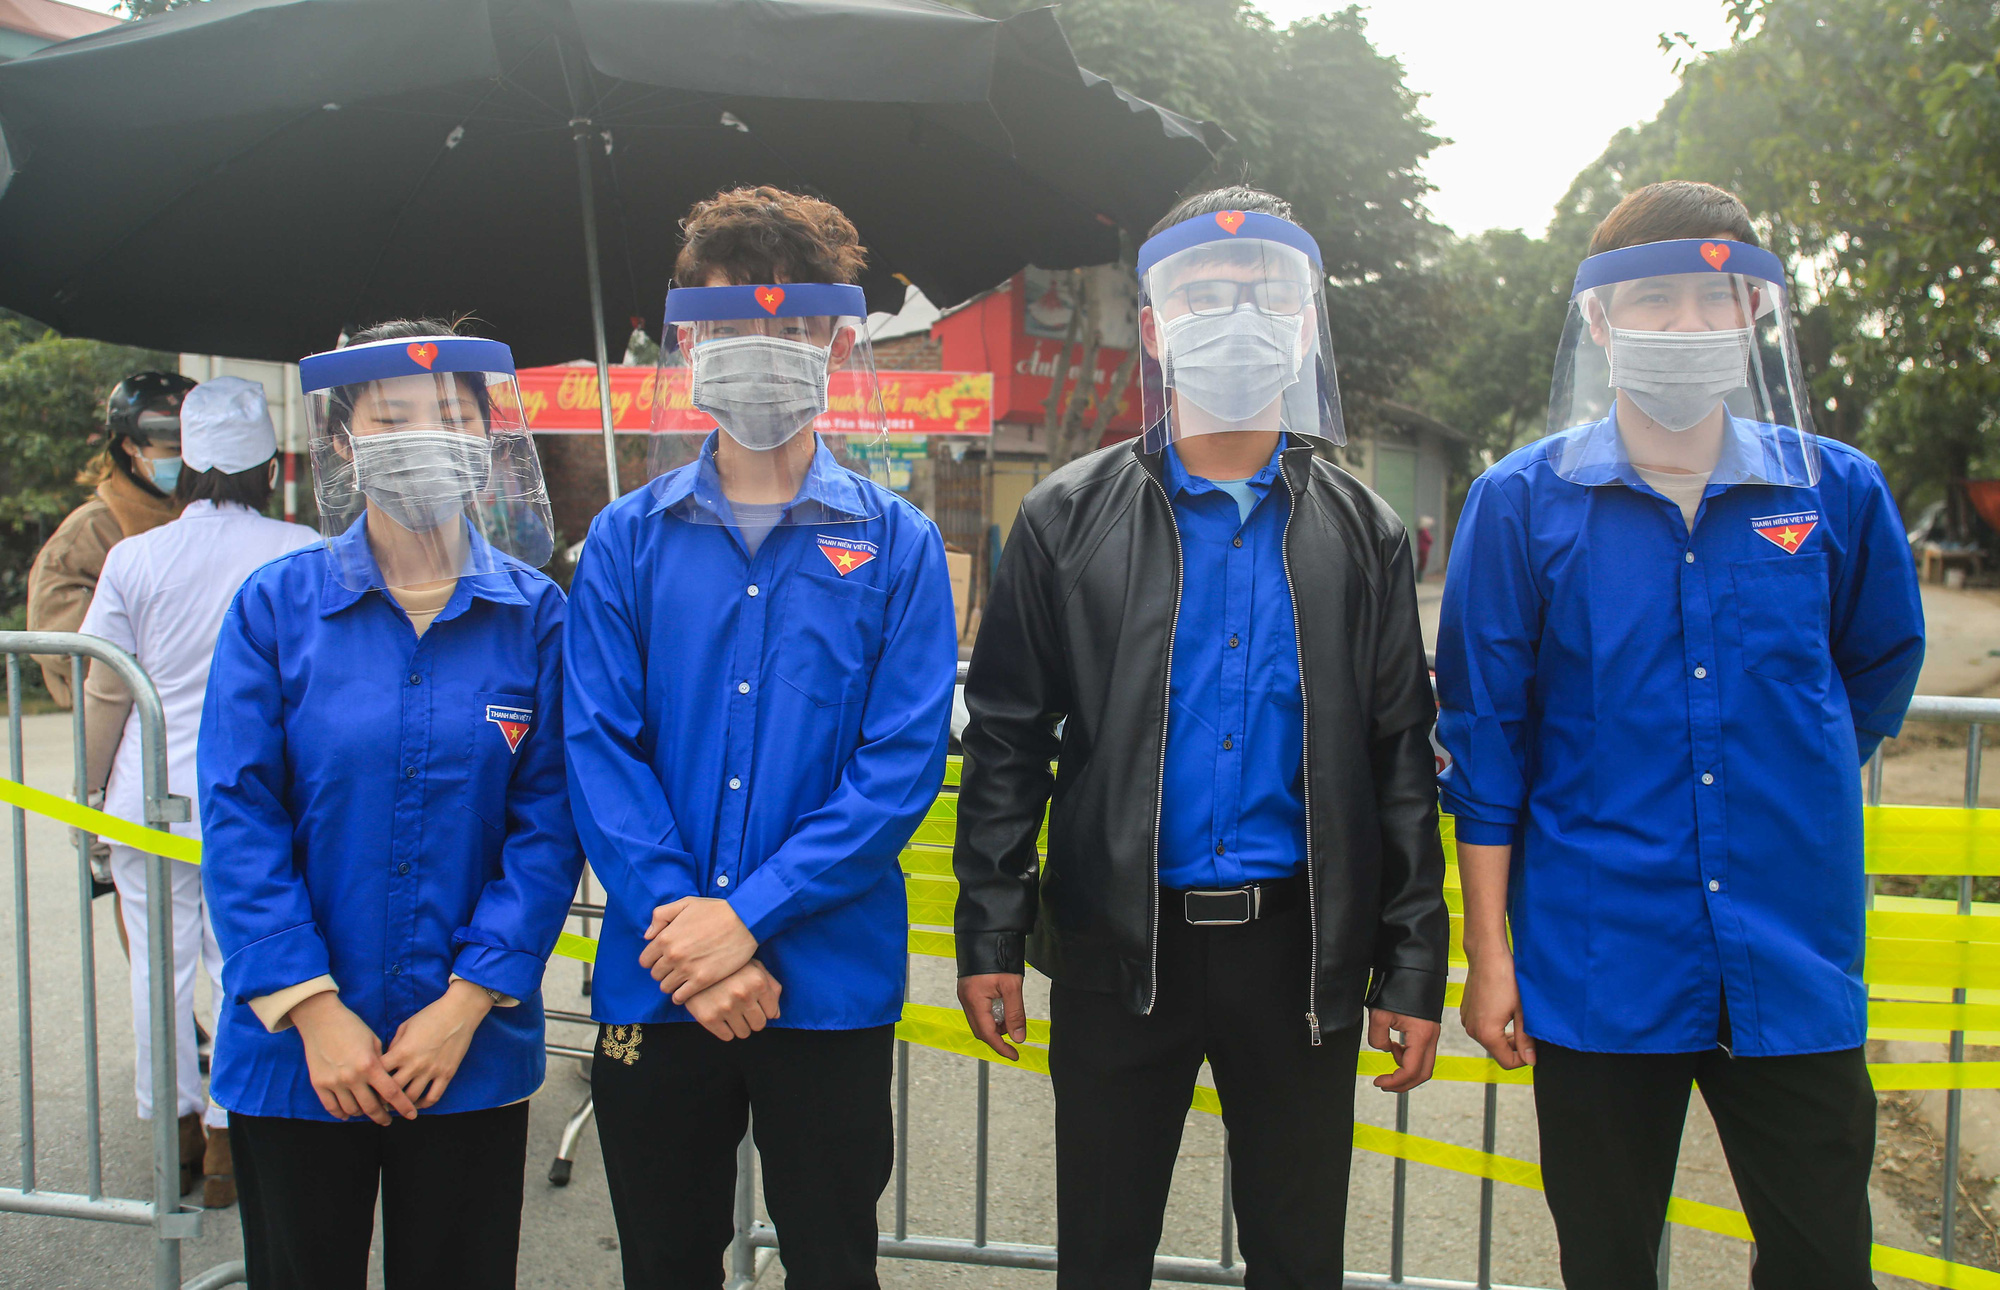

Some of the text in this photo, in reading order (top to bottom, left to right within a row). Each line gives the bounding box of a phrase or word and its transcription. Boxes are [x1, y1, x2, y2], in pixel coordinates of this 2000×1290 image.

[1752, 519, 1772, 528] THANH
[1773, 518, 1789, 526] NIÊN
[1789, 515, 1804, 524] VIỆT
[817, 538, 837, 547] THANH
[837, 541, 852, 549] NIÊN
[853, 543, 867, 551] VIỆT
[490, 711, 509, 719] THANH
